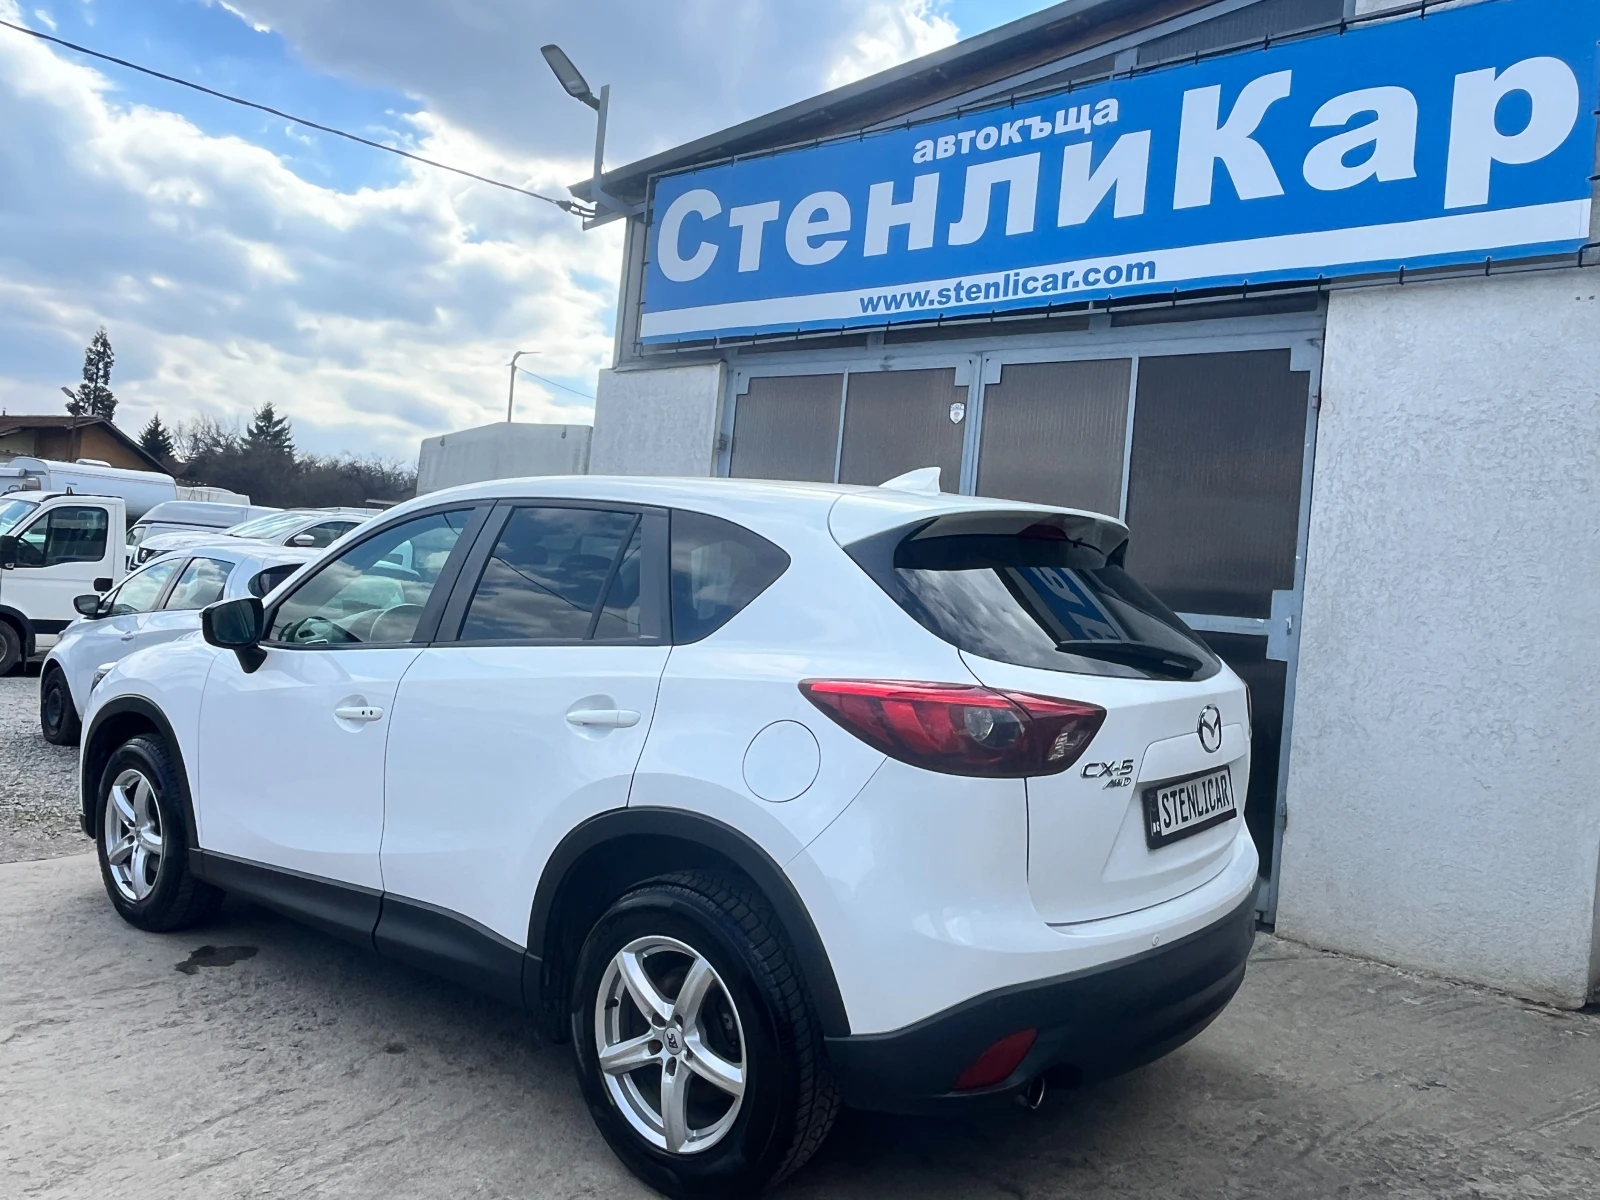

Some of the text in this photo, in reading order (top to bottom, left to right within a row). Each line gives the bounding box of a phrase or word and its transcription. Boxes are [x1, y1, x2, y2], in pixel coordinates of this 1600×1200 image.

[912, 98, 1119, 163] автокъща
[860, 260, 1156, 313] www.stenlicar.com
[1081, 759, 1134, 778] CX-5
[1161, 774, 1230, 828] STENLICAR
